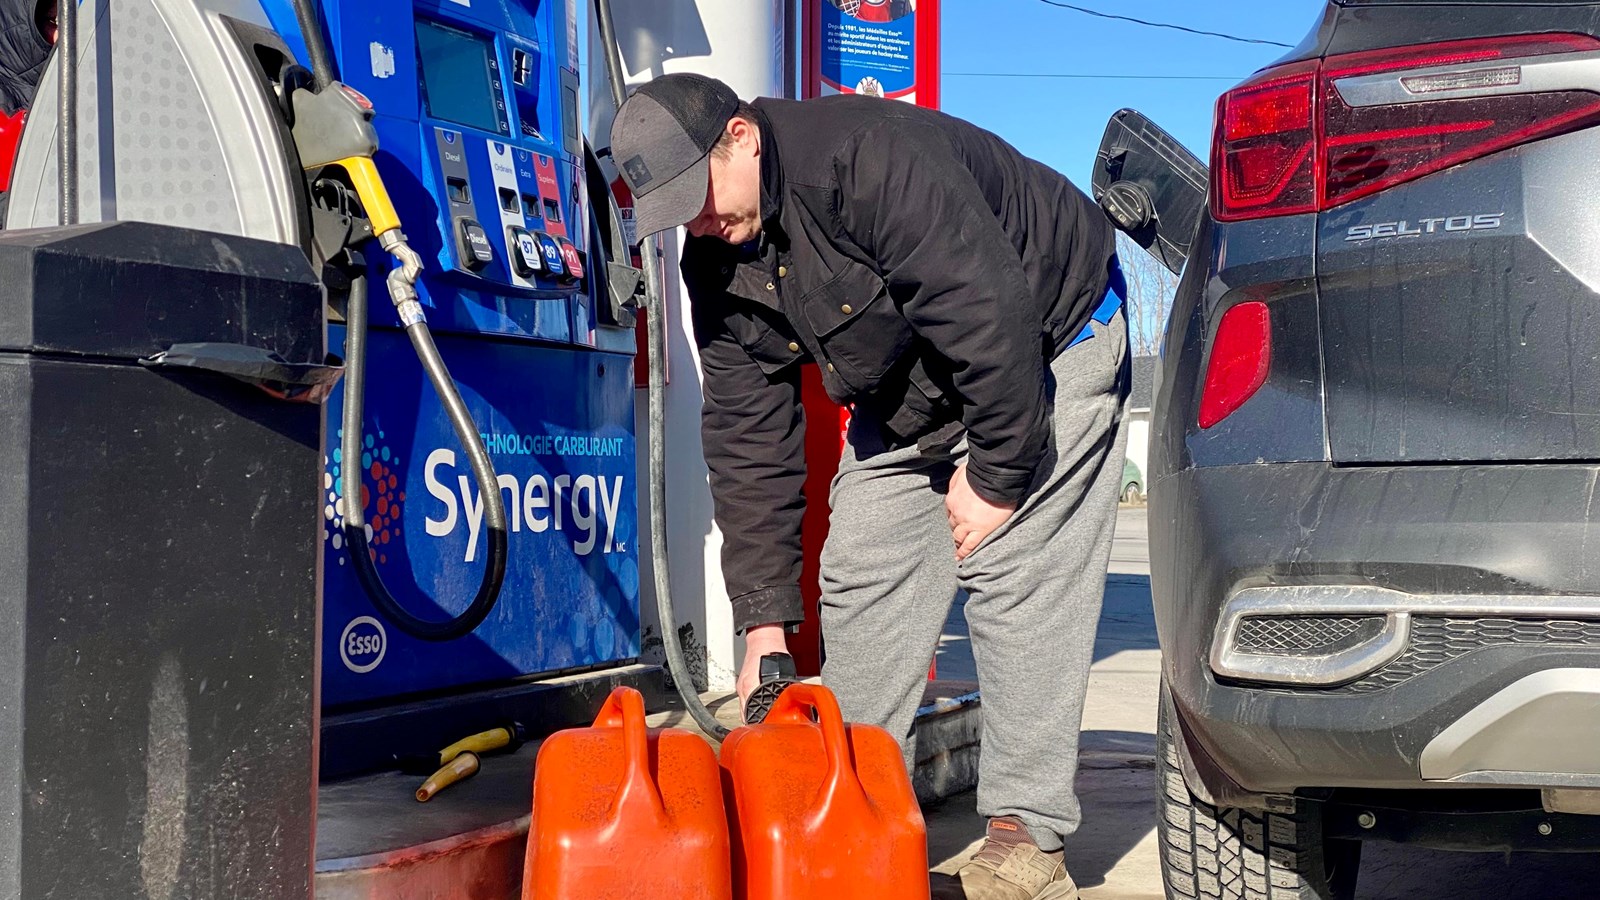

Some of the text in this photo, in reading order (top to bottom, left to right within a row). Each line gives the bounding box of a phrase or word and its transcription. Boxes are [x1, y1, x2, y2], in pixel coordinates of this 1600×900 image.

[828, 23, 844, 31] Depuis
[866, 27, 887, 36] Médailles
[841, 39, 876, 48] administrateurs
[828, 45, 847, 53] valoriser
[878, 50, 893, 59] hockey
[445, 152, 461, 162] Diesel
[520, 169, 531, 179] Extra
[1344, 213, 1505, 242] SELTOS
[469, 233, 487, 245] Diesel
[522, 240, 533, 255] 87
[544, 245, 556, 259] 89
[565, 249, 577, 264] 91
[554, 436, 623, 457] CARBURANT
[424, 448, 626, 562] Synergy MC
[348, 632, 379, 655] Esso
